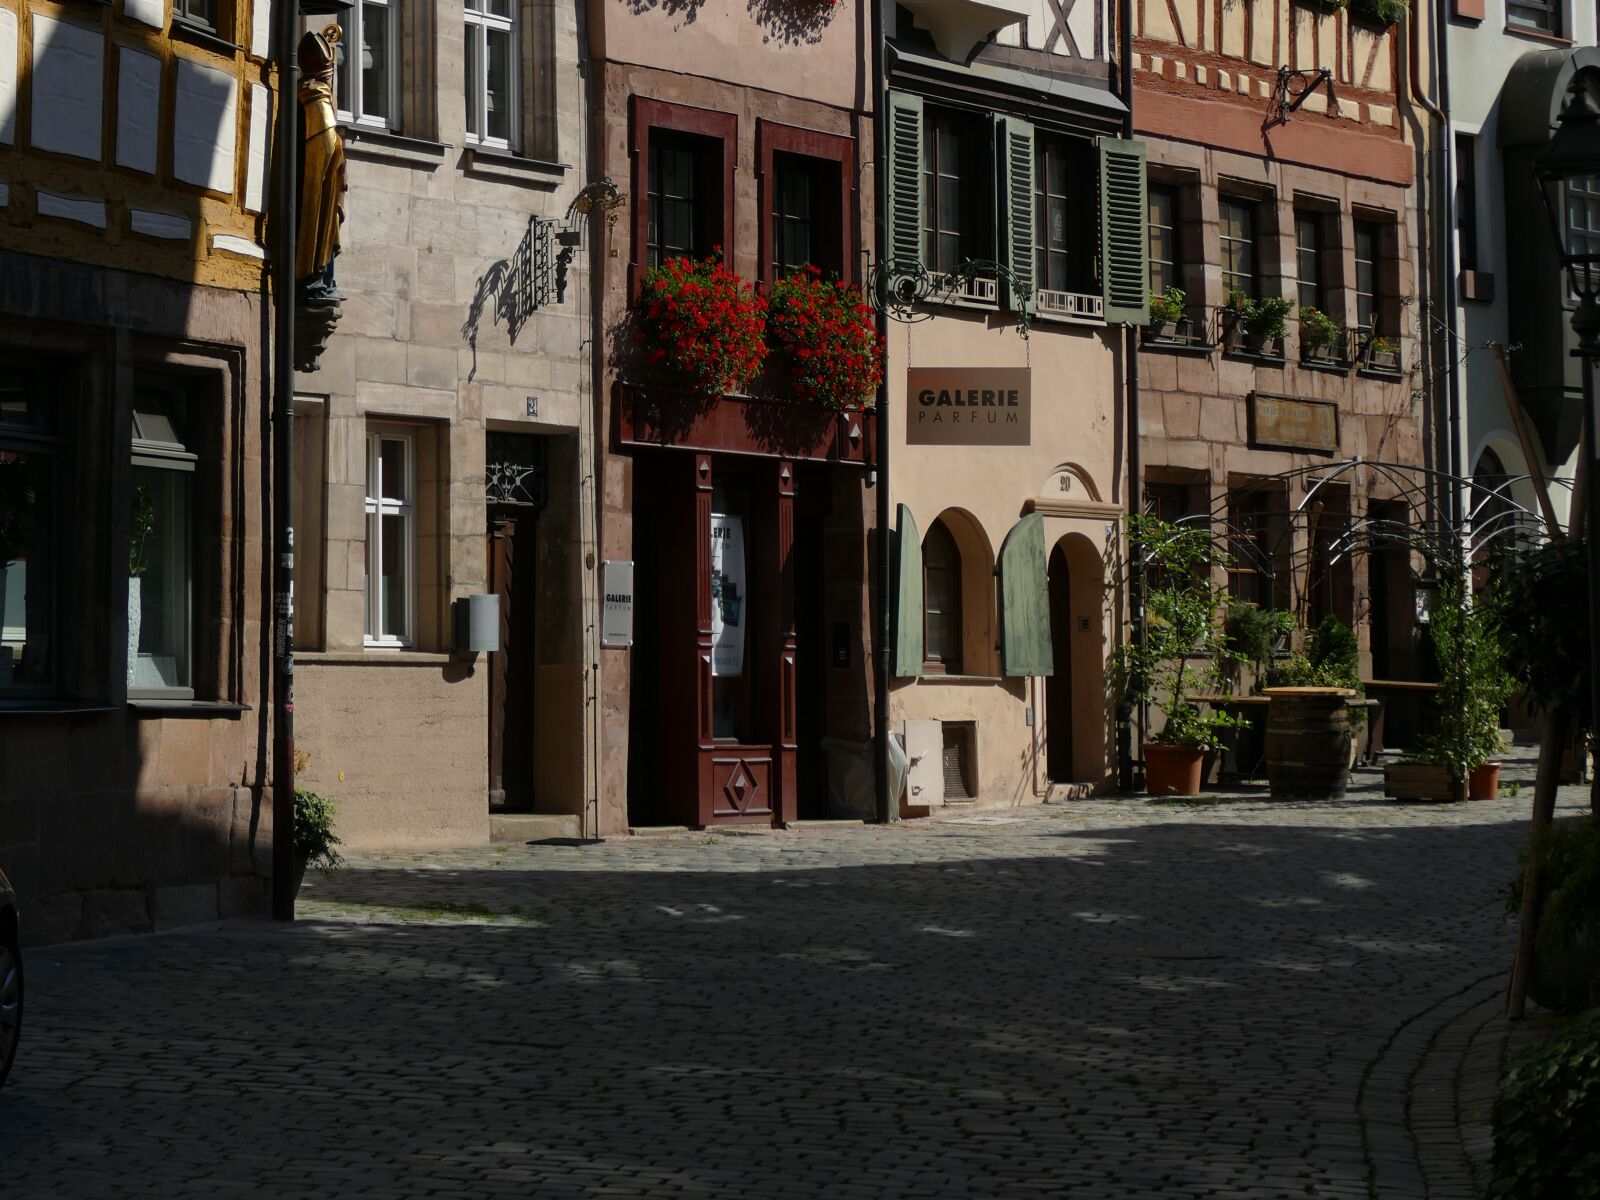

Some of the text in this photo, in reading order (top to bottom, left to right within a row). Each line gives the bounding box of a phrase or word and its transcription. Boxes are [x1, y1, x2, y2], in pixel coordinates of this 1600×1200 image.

[918, 389, 1019, 407] GALERIE
[918, 411, 1018, 424] PARFUM
[1060, 475, 1071, 492] 20
[606, 593, 632, 603] GALERIE
